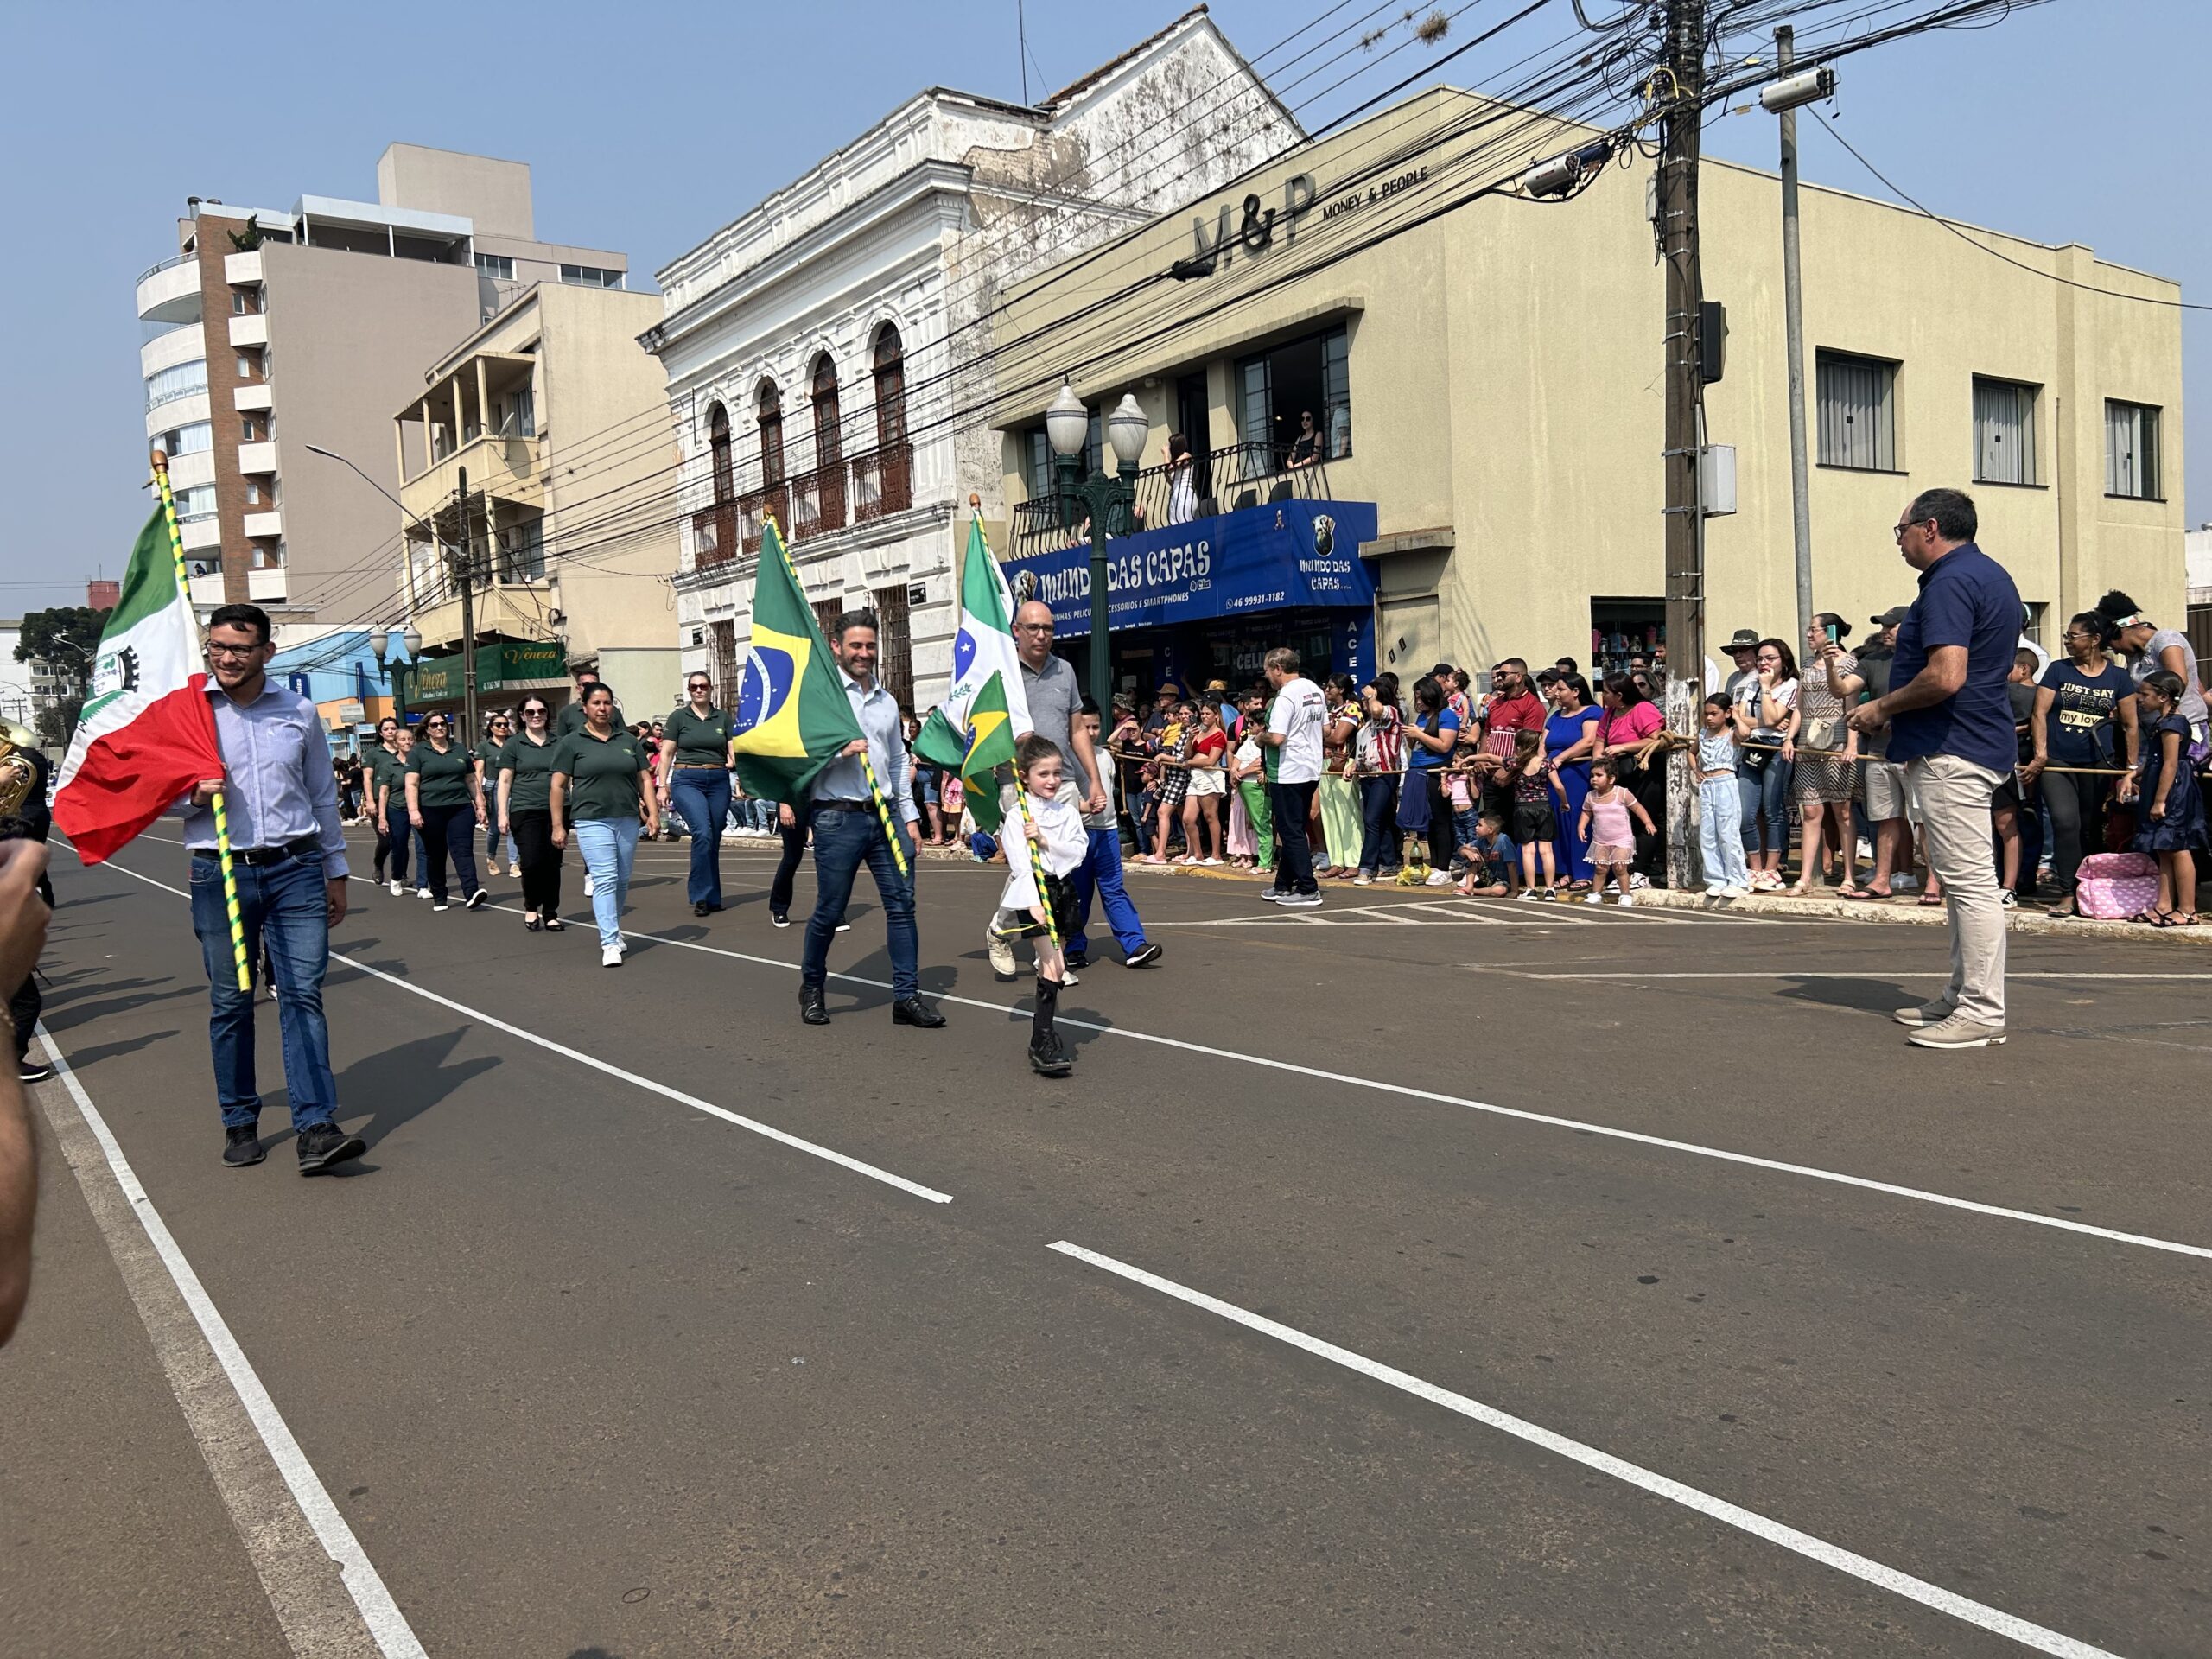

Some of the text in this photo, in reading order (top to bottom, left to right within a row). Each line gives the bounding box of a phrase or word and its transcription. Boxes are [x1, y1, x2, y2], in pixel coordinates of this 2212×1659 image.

[1323, 166, 1428, 221] MONEY & PEOPLE
[1040, 540, 1211, 605] MUND DAS CAPAS
[1332, 560, 1351, 573] DAS
[1198, 578, 1211, 590] Cia
[1311, 576, 1339, 590] CAPAS
[1139, 600, 1143, 608] E
[1144, 591, 1189, 607] SMARTPHONES
[1233, 591, 1285, 607] 46 99931-1182
[505, 647, 556, 664] Veneza
[1347, 621, 1358, 684] ACES
[409, 667, 448, 699] Veneza
[2060, 683, 2114, 698] JUST SAY
[2061, 691, 2113, 715] YES
[2061, 713, 2099, 724] my lov
